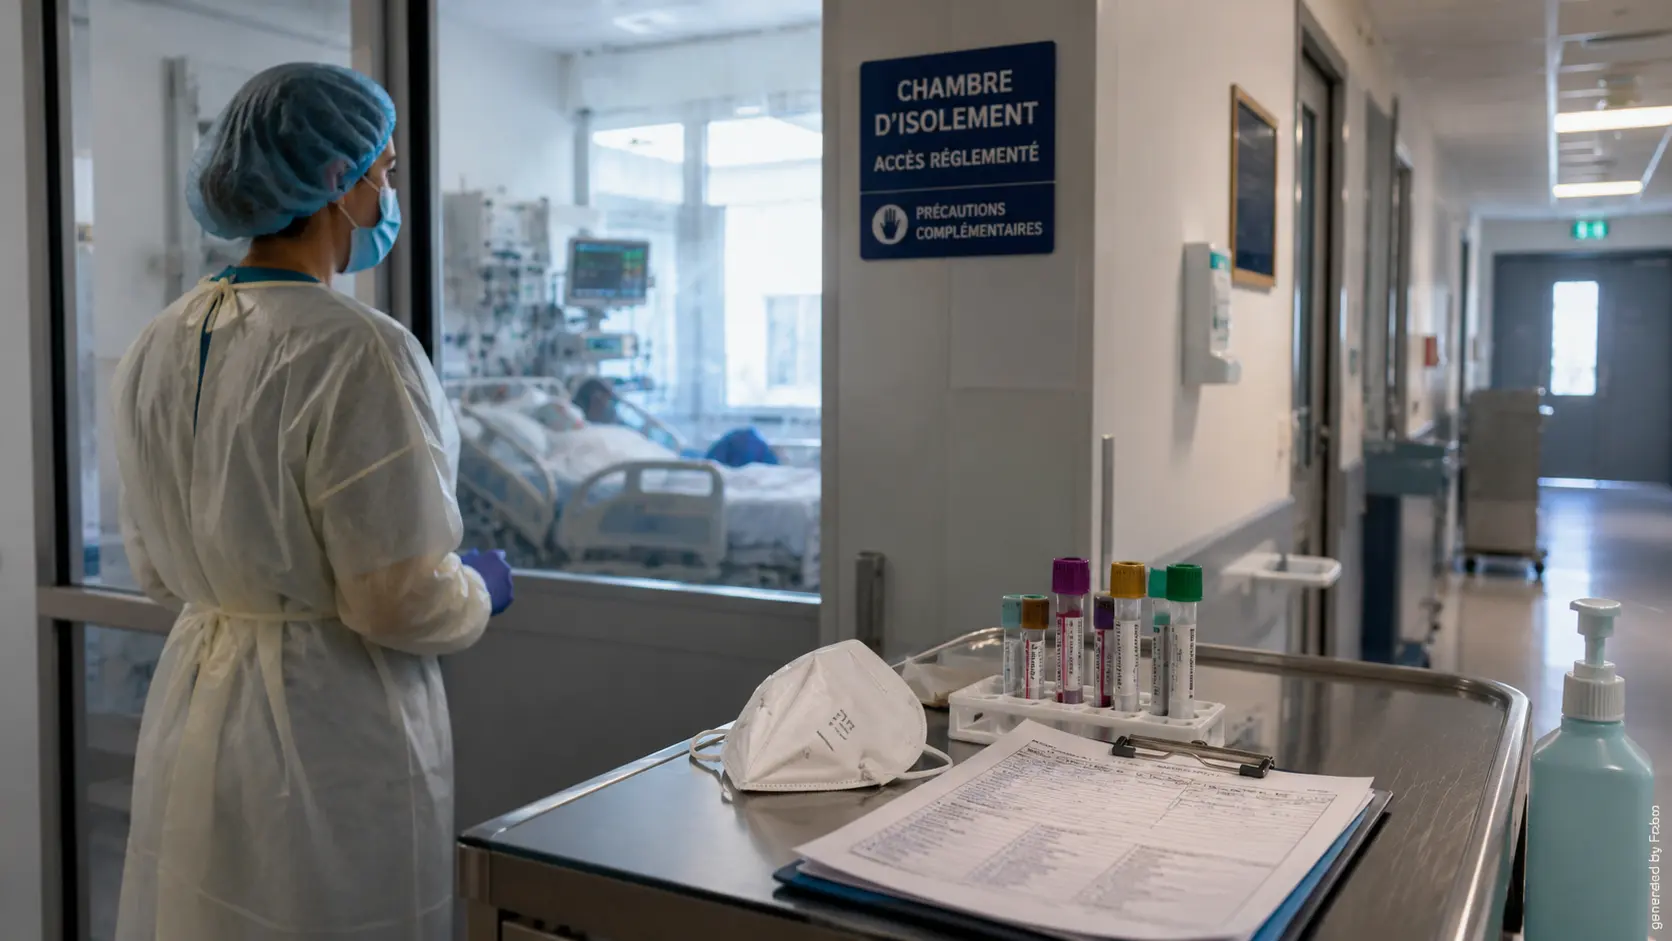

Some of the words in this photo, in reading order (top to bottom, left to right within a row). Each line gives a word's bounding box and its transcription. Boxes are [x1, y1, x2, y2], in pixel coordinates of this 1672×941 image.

[897, 69, 1013, 102] CHAMBRE
[874, 101, 1039, 137] D'ISOLEMENT
[873, 150, 926, 172] ACCÈS
[930, 141, 1040, 169] RÉGLEMENTÉ
[916, 202, 1006, 220] PRÉCAUTIONS
[916, 221, 1044, 241] COMPLÉMENTAIRES
